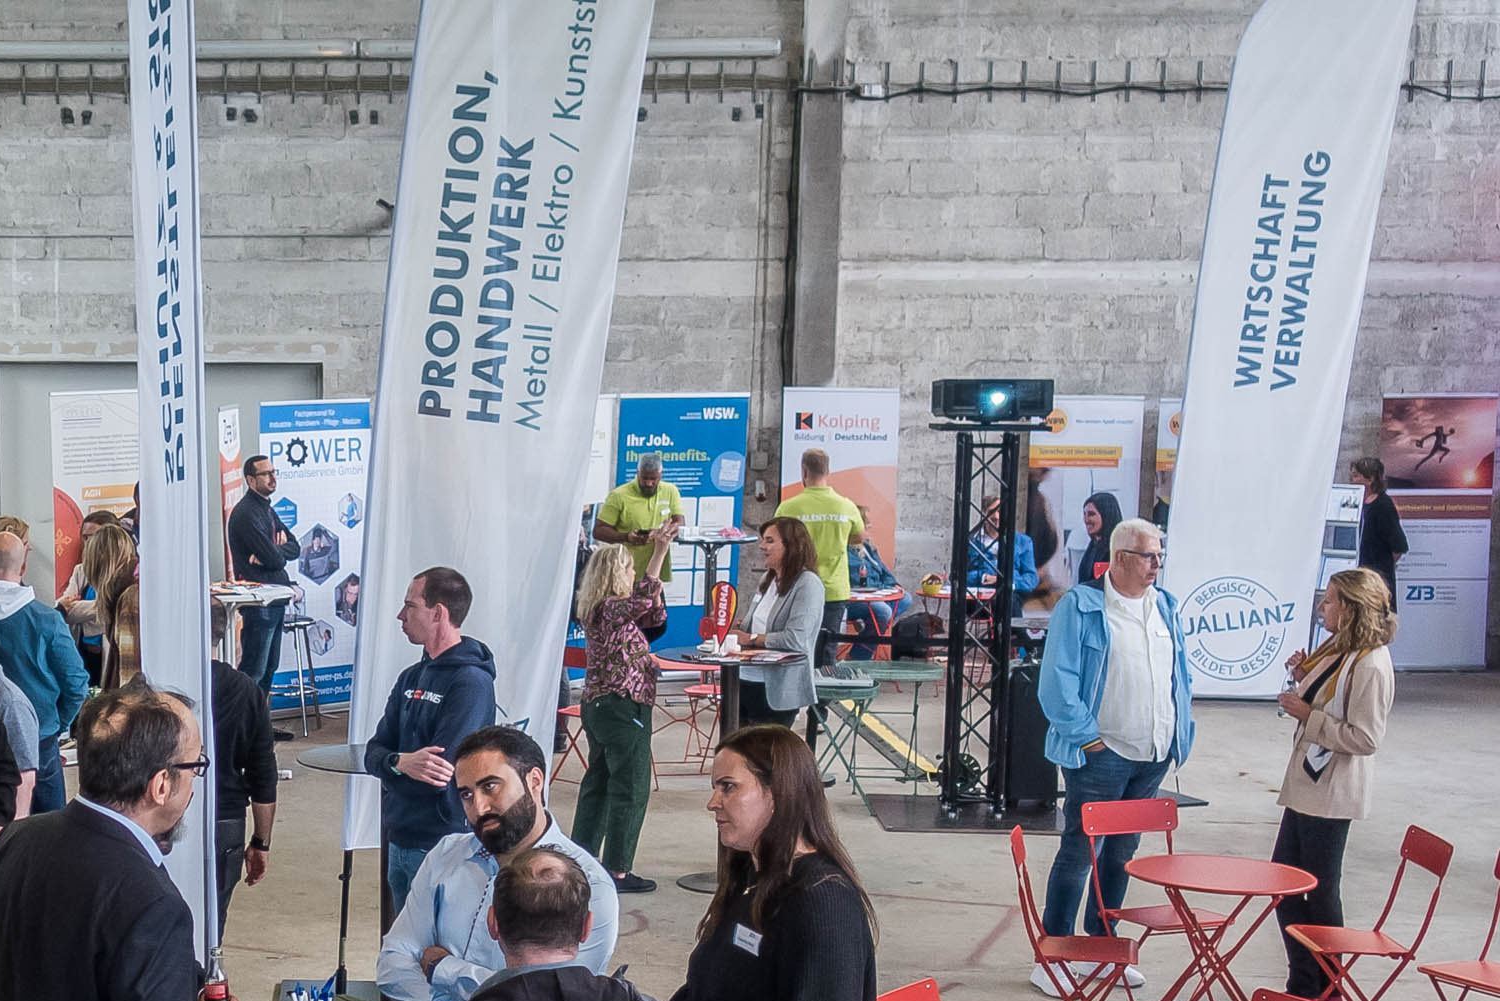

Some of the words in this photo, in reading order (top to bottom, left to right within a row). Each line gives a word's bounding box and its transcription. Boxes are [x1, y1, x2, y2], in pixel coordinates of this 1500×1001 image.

[417, 70, 499, 418] PRODUKTION,
[531, 164, 575, 283] Elektro
[466, 136, 535, 424] HANDWERK
[1233, 173, 1290, 388] WIRTSCHAFT
[1269, 151, 1331, 391] VERWALTUNG
[513, 323, 553, 431] Metall
[626, 434, 646, 447] Ihr
[646, 433, 674, 447] Job.
[794, 433, 825, 442] Bildung
[834, 432, 888, 441] Deutschland
[818, 414, 881, 431] Kolping
[270, 437, 363, 467] POWER
[276, 468, 337, 480] rsonalservice
[716, 584, 730, 627] NORMA
[1195, 582, 1257, 606] BERGISCH
[1191, 648, 1235, 675] BILDET
[1240, 635, 1280, 675] BESSER
